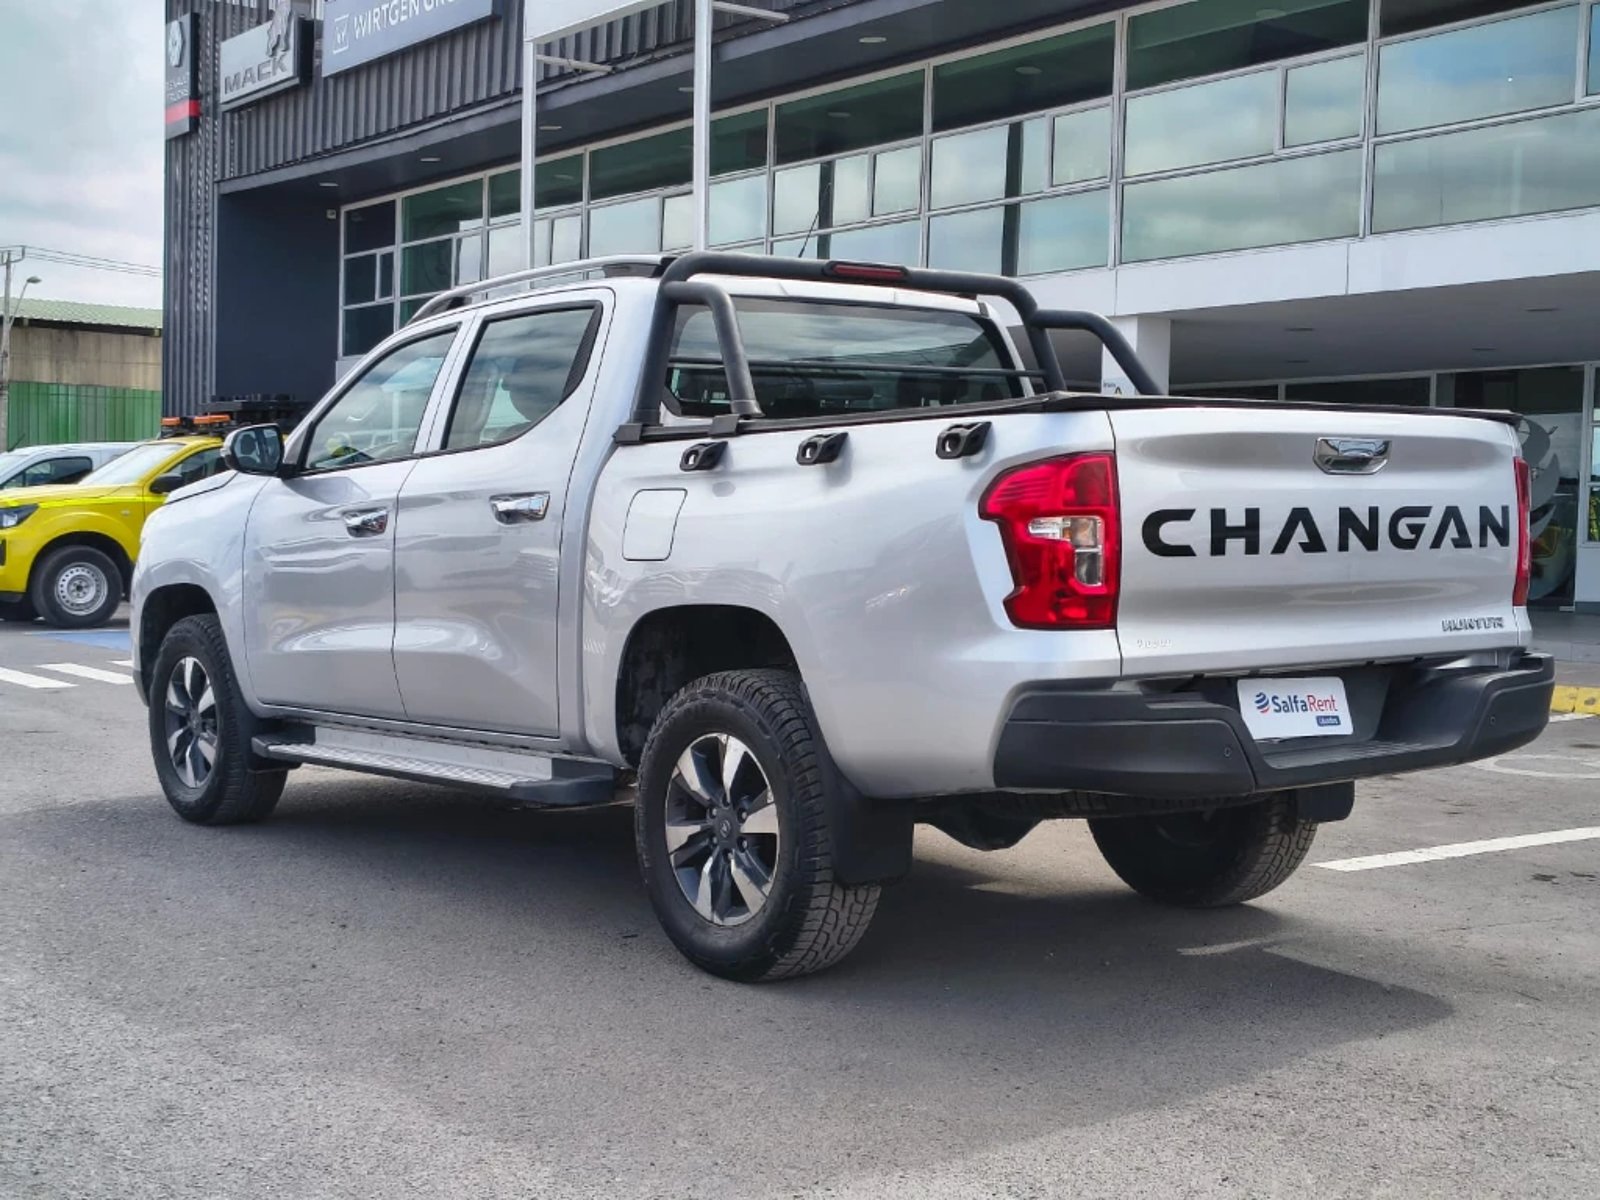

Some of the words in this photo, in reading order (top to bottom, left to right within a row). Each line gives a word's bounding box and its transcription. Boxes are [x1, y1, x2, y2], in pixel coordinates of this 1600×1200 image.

[353, 0, 420, 39] WIRTGEN
[224, 52, 287, 95] MACK
[1141, 505, 1510, 557] CHANGAN
[1271, 694, 1338, 713] SalfaRent
